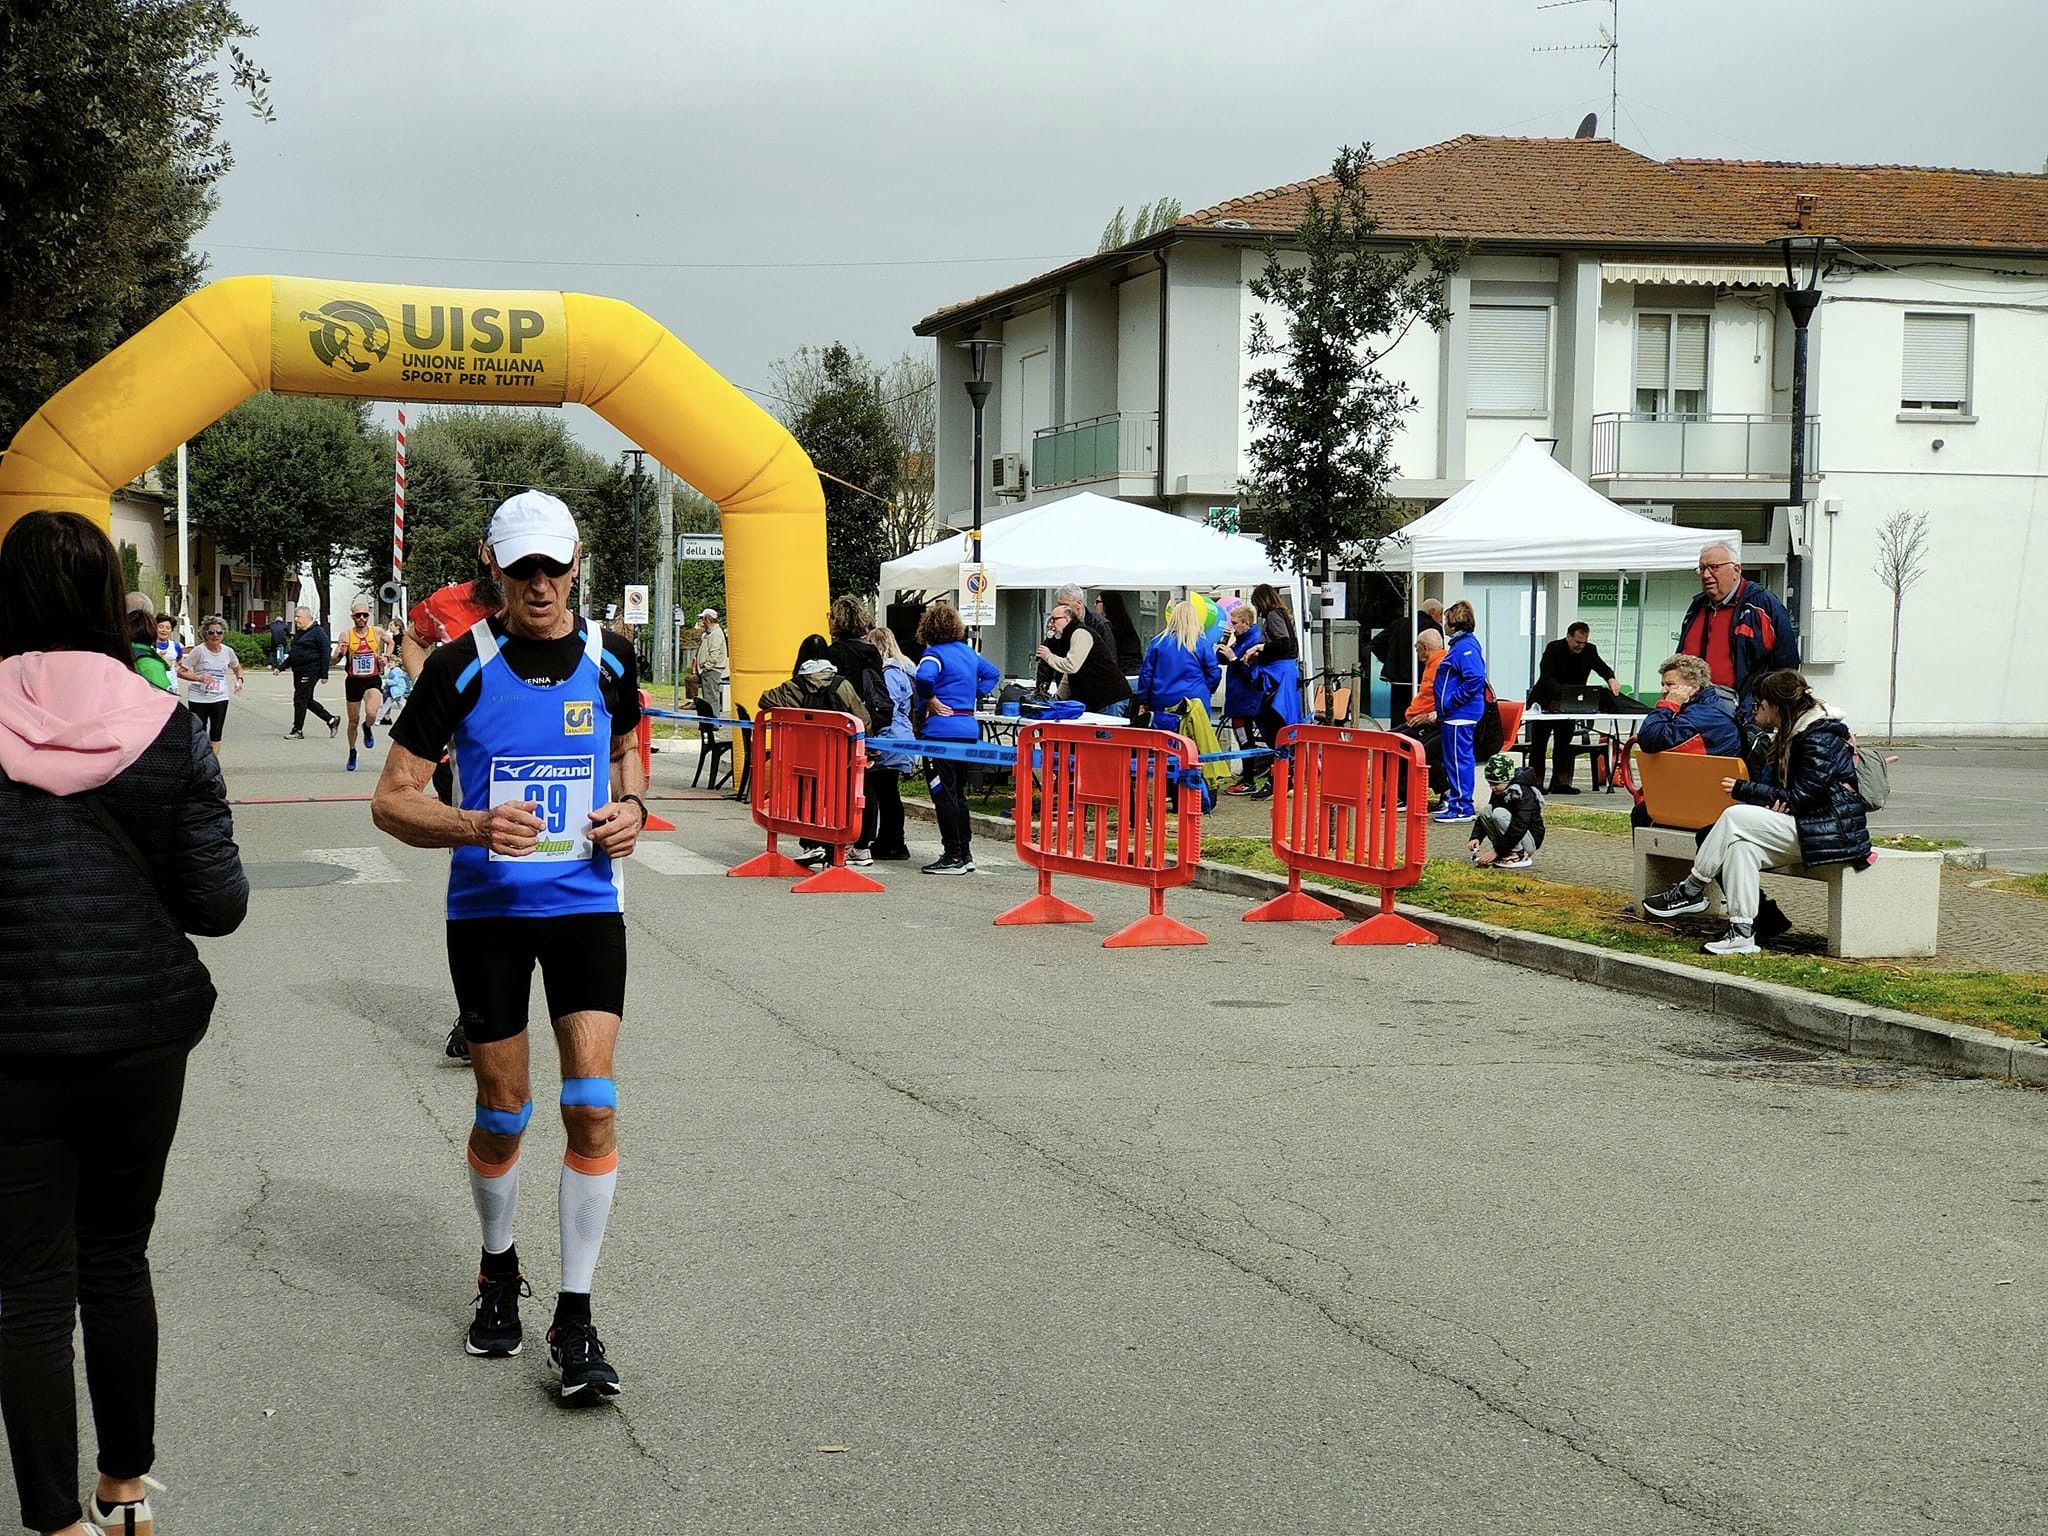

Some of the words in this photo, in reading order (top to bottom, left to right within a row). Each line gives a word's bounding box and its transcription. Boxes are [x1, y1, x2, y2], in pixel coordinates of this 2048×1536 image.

[402, 303, 545, 354] UISP
[402, 353, 465, 371] UNIONE
[473, 357, 544, 372] ITALIANA
[401, 370, 453, 384] SPORT
[459, 373, 486, 386] PER
[495, 374, 535, 387] TUTTI
[685, 546, 706, 556] della
[1581, 591, 1629, 601] Farmaca
[357, 659, 371, 670] 195
[523, 783, 567, 834] 69
